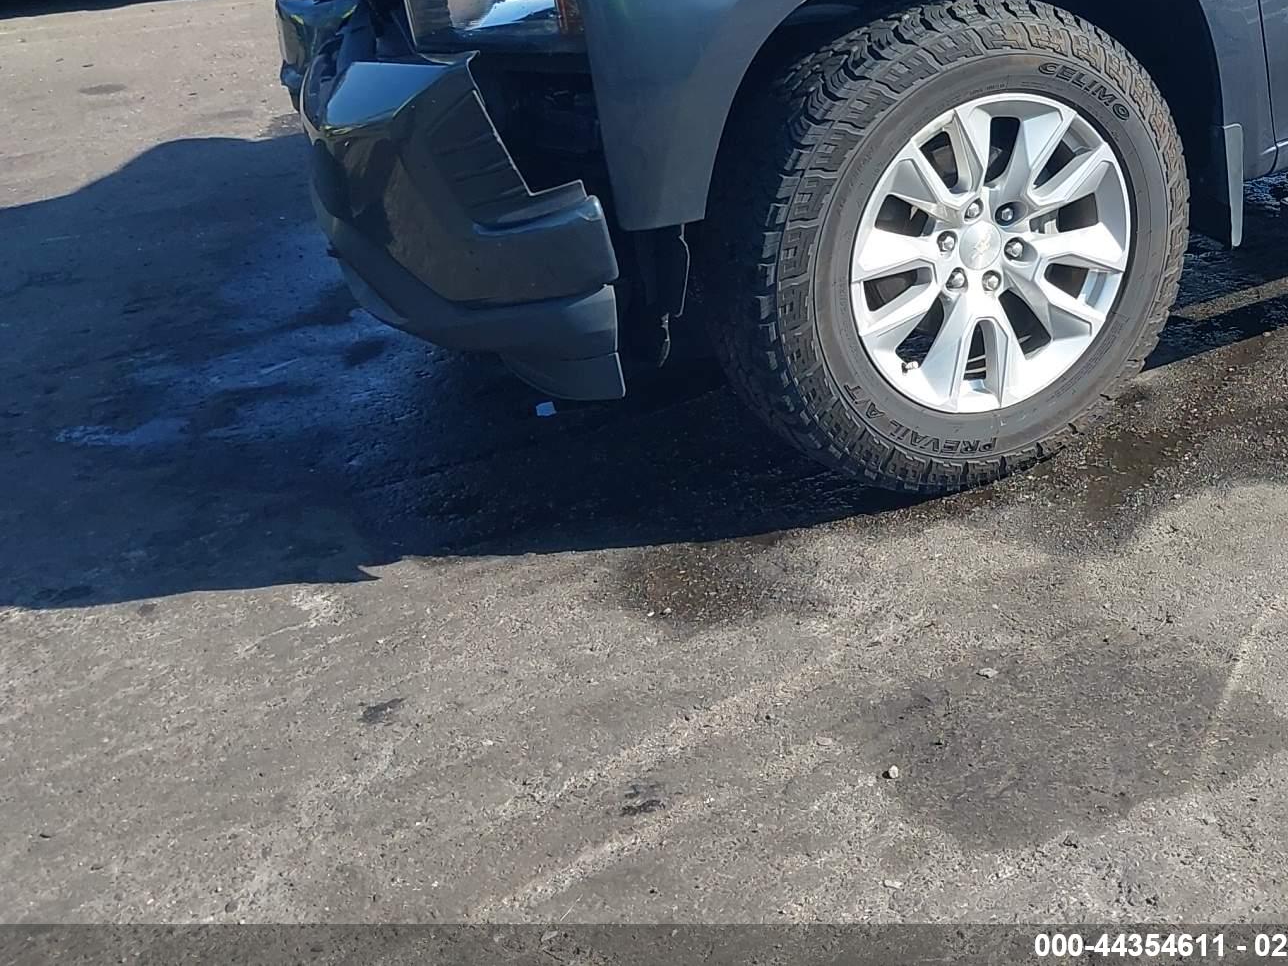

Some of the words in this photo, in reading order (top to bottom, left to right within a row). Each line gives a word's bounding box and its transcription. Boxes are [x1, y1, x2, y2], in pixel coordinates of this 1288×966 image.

[1038, 62, 1130, 121] CELIMO
[844, 384, 886, 419] A/T
[889, 419, 998, 454] PREVAIL
